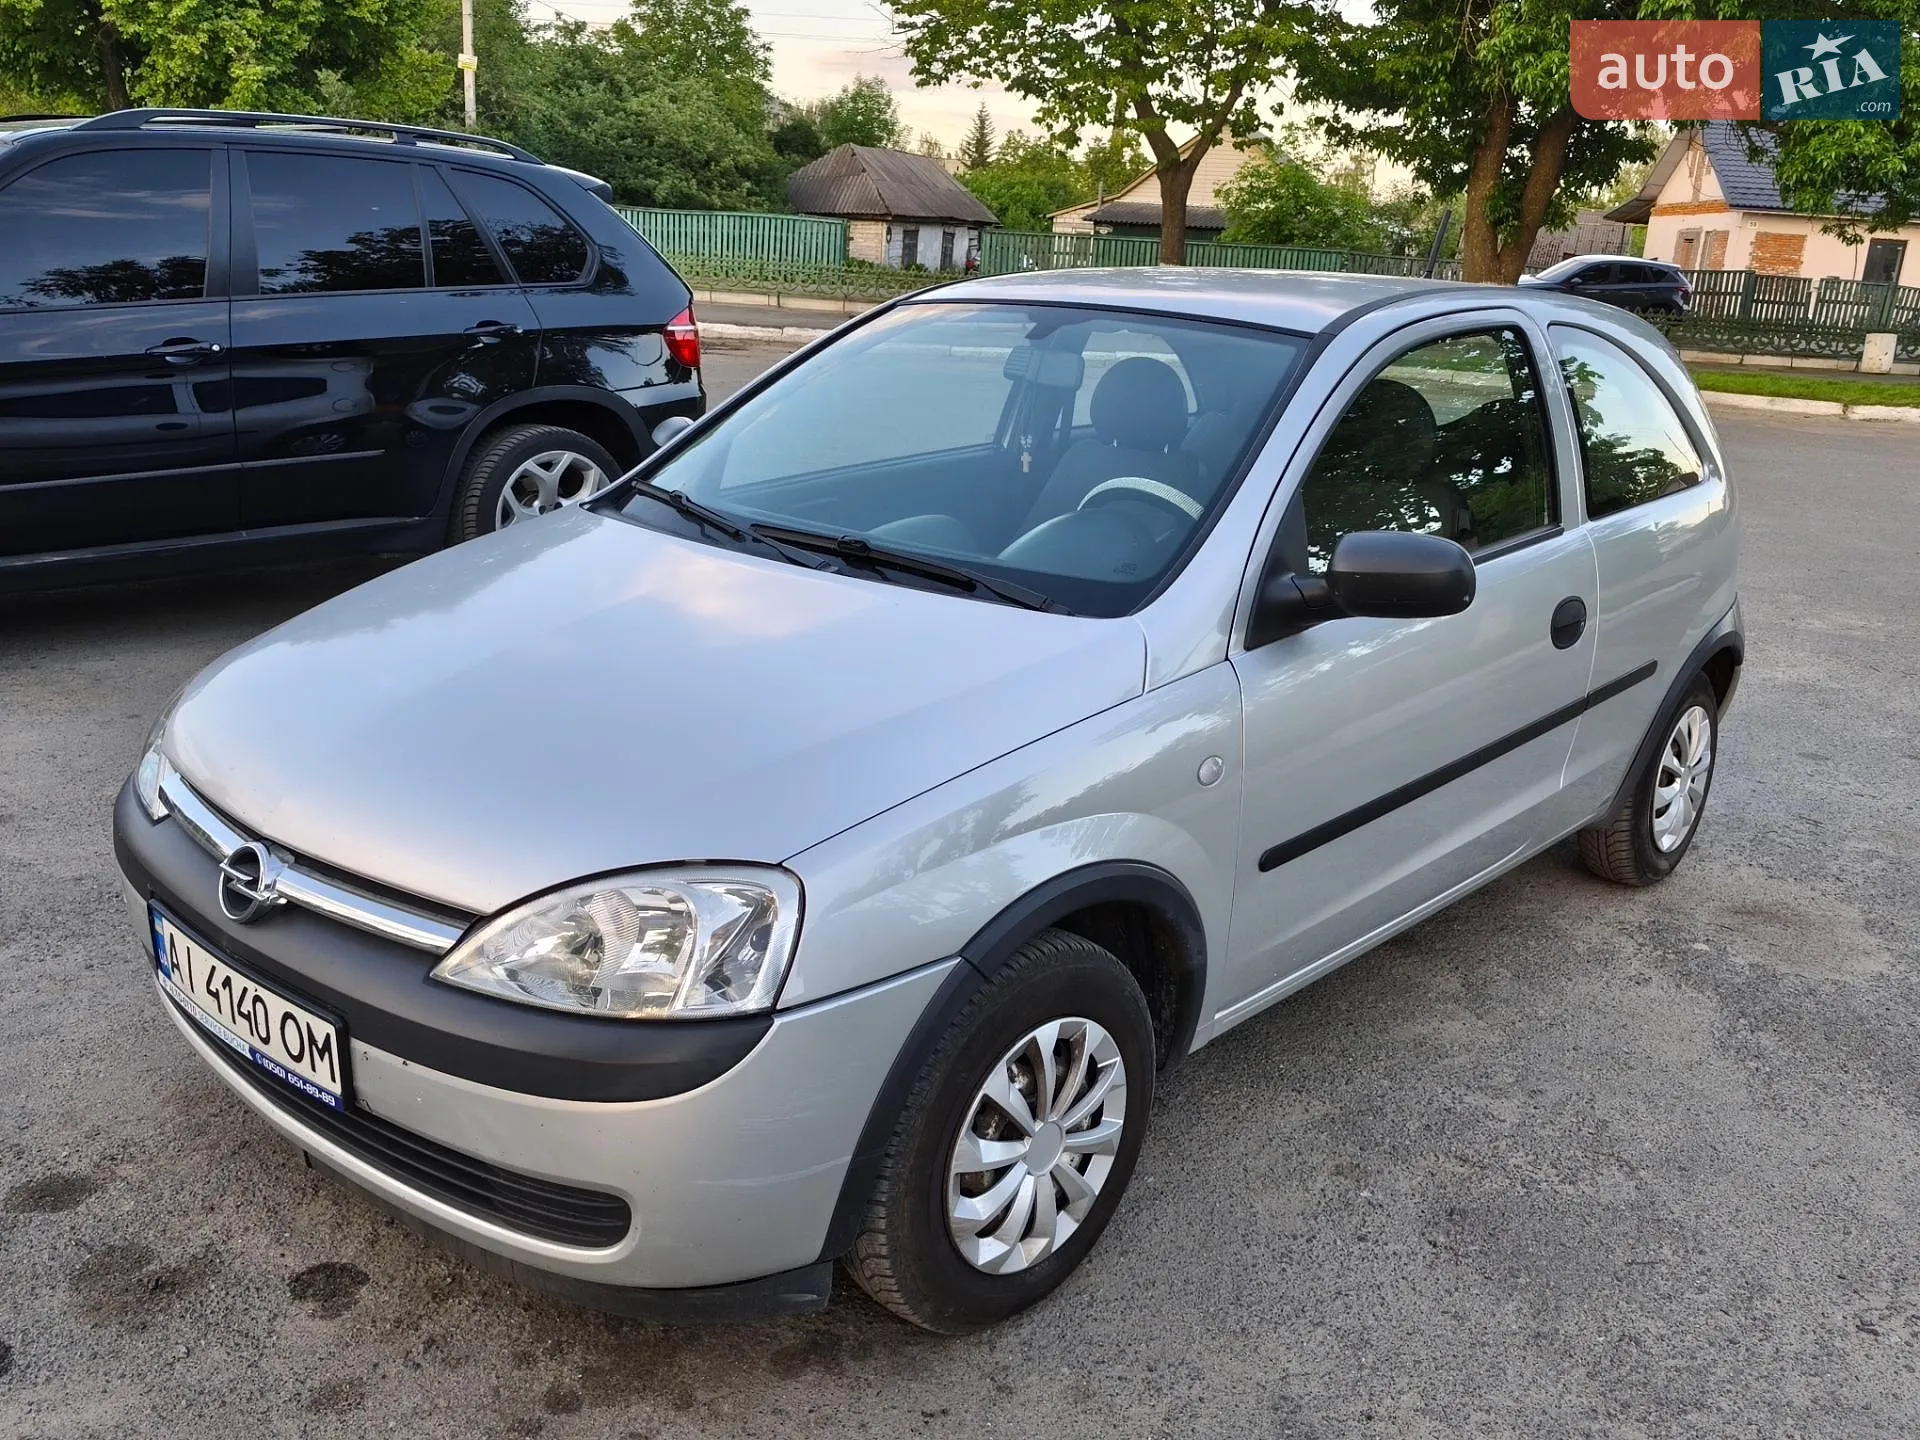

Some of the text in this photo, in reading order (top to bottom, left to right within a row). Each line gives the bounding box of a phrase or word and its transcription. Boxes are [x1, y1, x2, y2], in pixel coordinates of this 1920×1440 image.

[158, 948, 169, 968] UA
[169, 932, 195, 994] AI
[206, 965, 271, 1046] 4140
[280, 1011, 337, 1084] OM
[288, 1073, 336, 1107] 651-89-89
